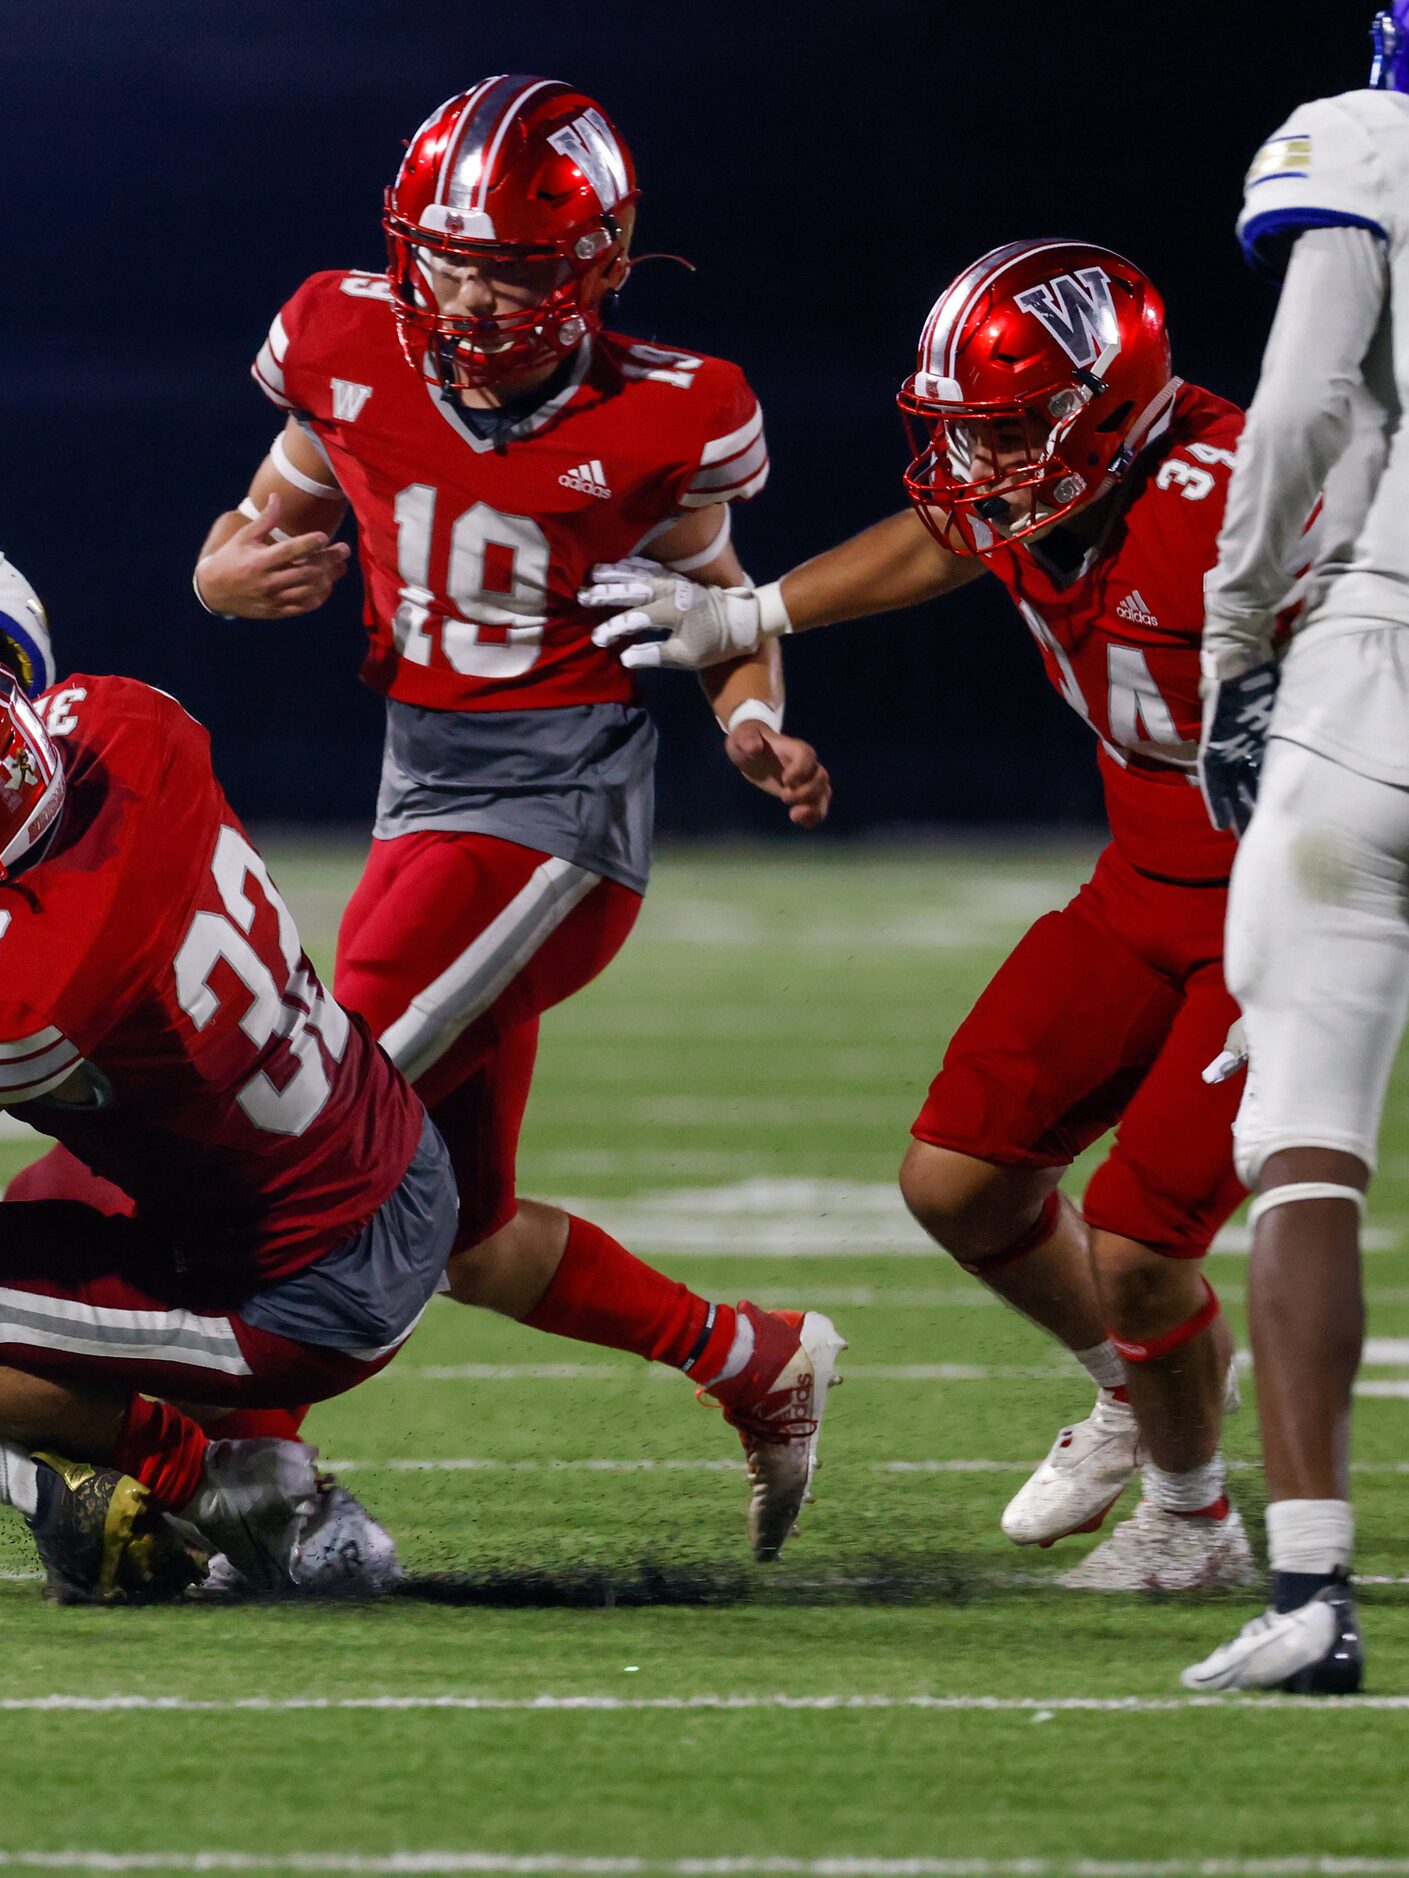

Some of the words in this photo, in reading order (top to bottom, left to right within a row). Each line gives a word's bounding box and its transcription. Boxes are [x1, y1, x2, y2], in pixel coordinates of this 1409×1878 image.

[546, 107, 630, 212] W
[1013, 266, 1122, 368] W
[330, 377, 373, 422] W
[558, 474, 612, 499] adidas
[393, 482, 551, 679] 19
[1116, 606, 1159, 627] adidas
[172, 823, 351, 1137] 32
